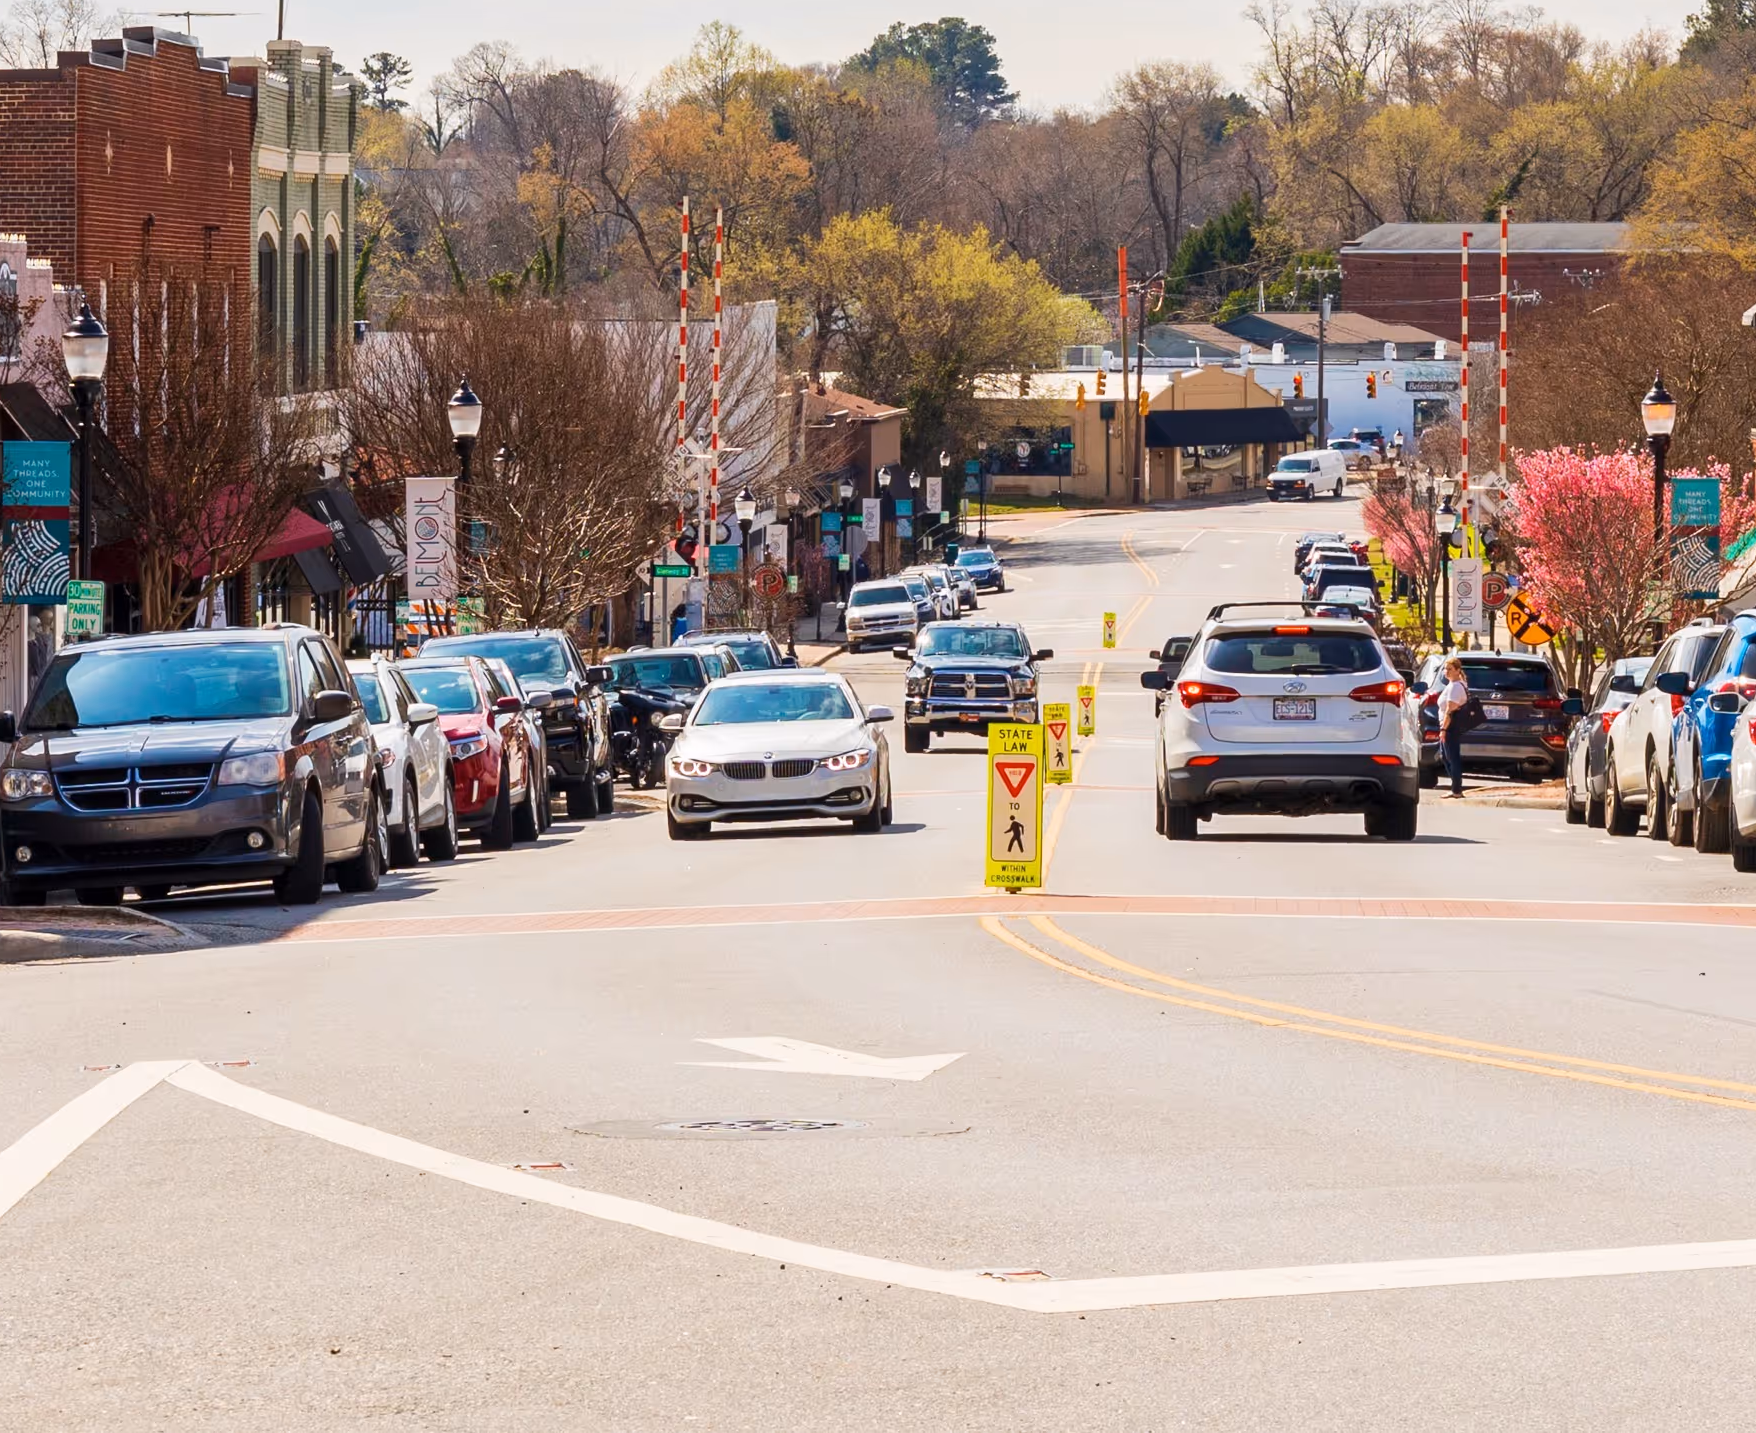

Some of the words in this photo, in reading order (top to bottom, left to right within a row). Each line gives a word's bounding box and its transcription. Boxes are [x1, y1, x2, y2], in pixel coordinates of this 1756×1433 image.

[23, 459, 50, 468] MANY
[26, 479, 47, 488] ONE
[68, 583, 81, 597] 30
[1487, 583, 1503, 600] P
[69, 603, 101, 615] PARKING
[1511, 611, 1522, 624] R
[72, 618, 96, 630] ONLY
[999, 729, 1033, 739] STATE
[1004, 742, 1027, 752] LAW
[1009, 802, 1020, 810] TO
[990, 875, 1035, 883] CROSSWALK
